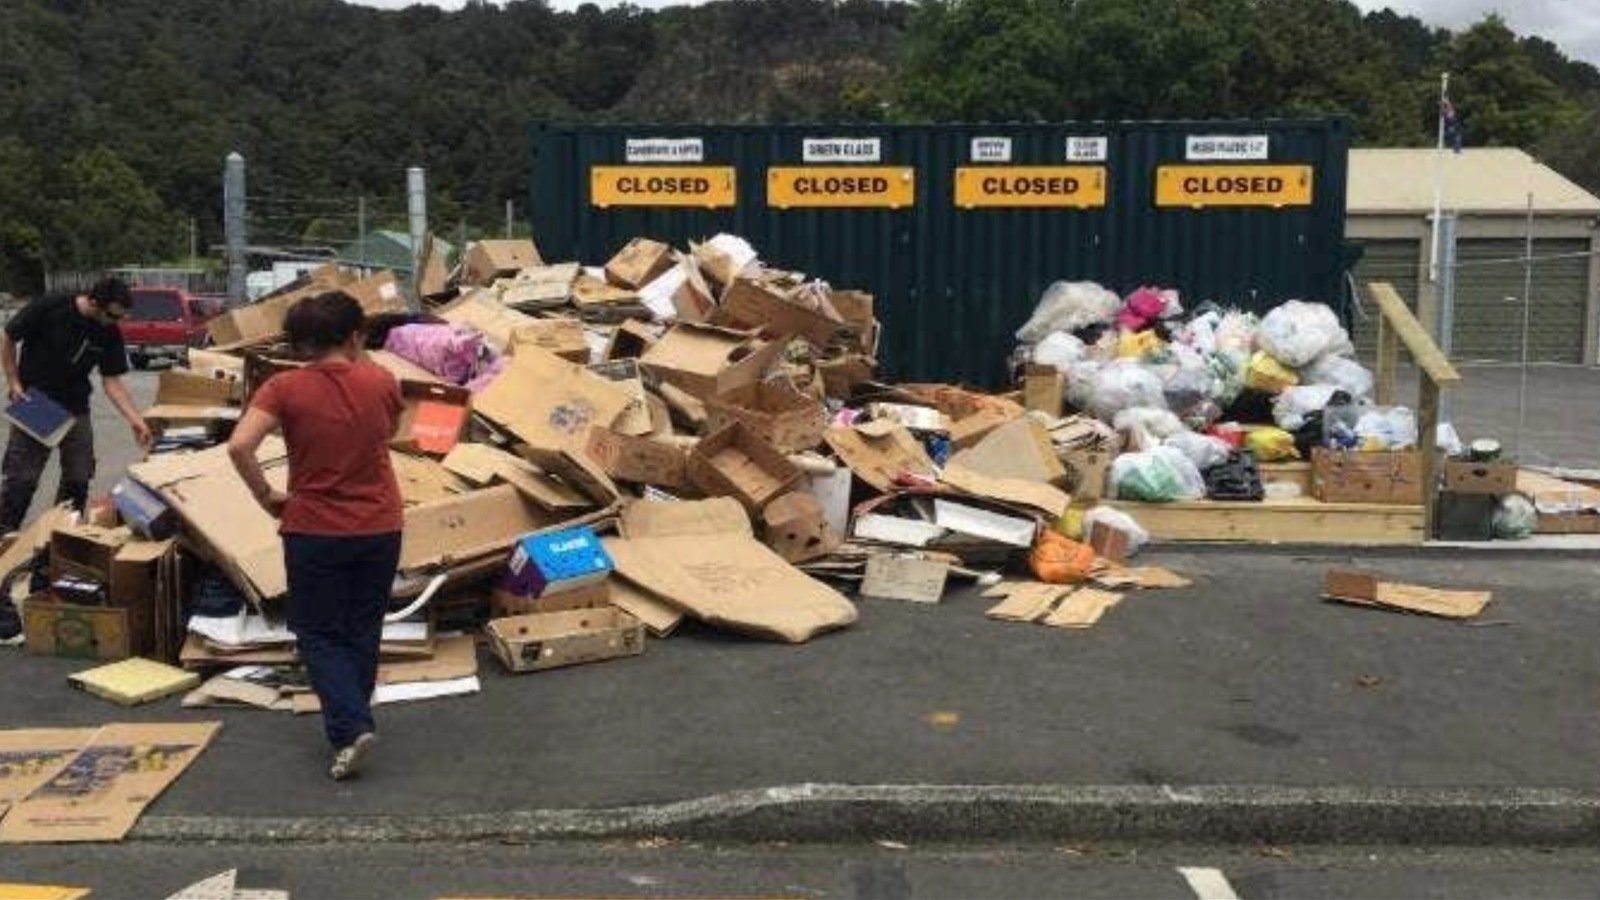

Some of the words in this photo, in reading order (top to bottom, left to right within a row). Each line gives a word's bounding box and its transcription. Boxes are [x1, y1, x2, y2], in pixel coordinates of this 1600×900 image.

[616, 177, 709, 193] CLOSED
[793, 177, 888, 193] CLOSED
[982, 177, 1079, 194] CLOSED
[1183, 176, 1283, 193] CLOSED
